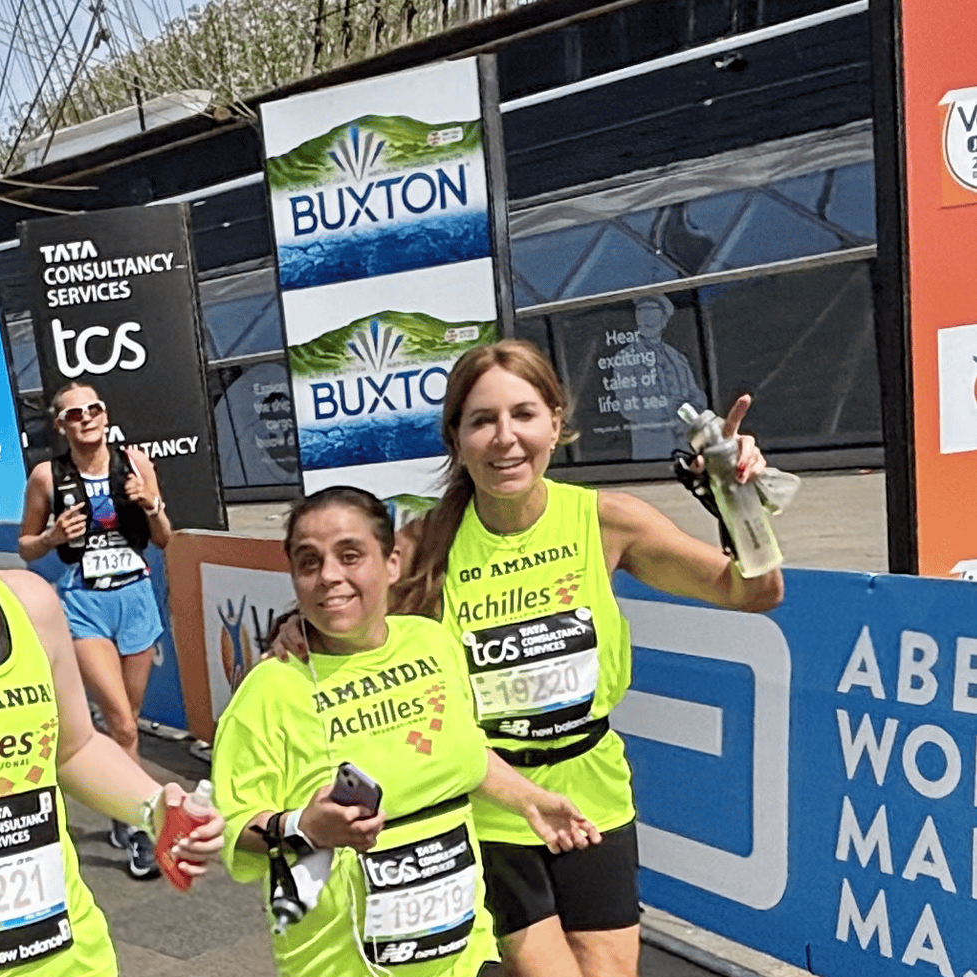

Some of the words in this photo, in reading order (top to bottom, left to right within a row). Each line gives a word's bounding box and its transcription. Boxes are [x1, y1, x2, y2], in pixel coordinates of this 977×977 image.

[289, 164, 468, 236] BUXTON
[39, 240, 98, 263] TATA
[43, 252, 174, 286] CONSULTANCY
[47, 280, 131, 308] SERVICES
[51, 318, 146, 378] tcs
[605, 330, 640, 346] Hear
[597, 348, 656, 370] exciting
[602, 372, 637, 391] tales
[641, 368, 657, 386] of
[598, 396, 620, 413] life
[623, 396, 640, 411] at
[642, 395, 668, 410] sea
[459, 567, 482, 583] GO
[490, 542, 579, 578] AMANDA!
[457, 586, 551, 625] Achilles
[519, 623, 549, 637] TATA
[521, 625, 587, 647] CONSULTANCY
[473, 636, 520, 666] tcs
[523, 640, 566, 658] SERVICES
[312, 656, 443, 714] AMANDA!
[329, 697, 424, 743] Achilles
[836, 708, 977, 807] WO
[415, 842, 443, 857] TATA
[836, 795, 977, 900] MA
[366, 857, 421, 887] tcs
[389, 884, 464, 929] 19219
